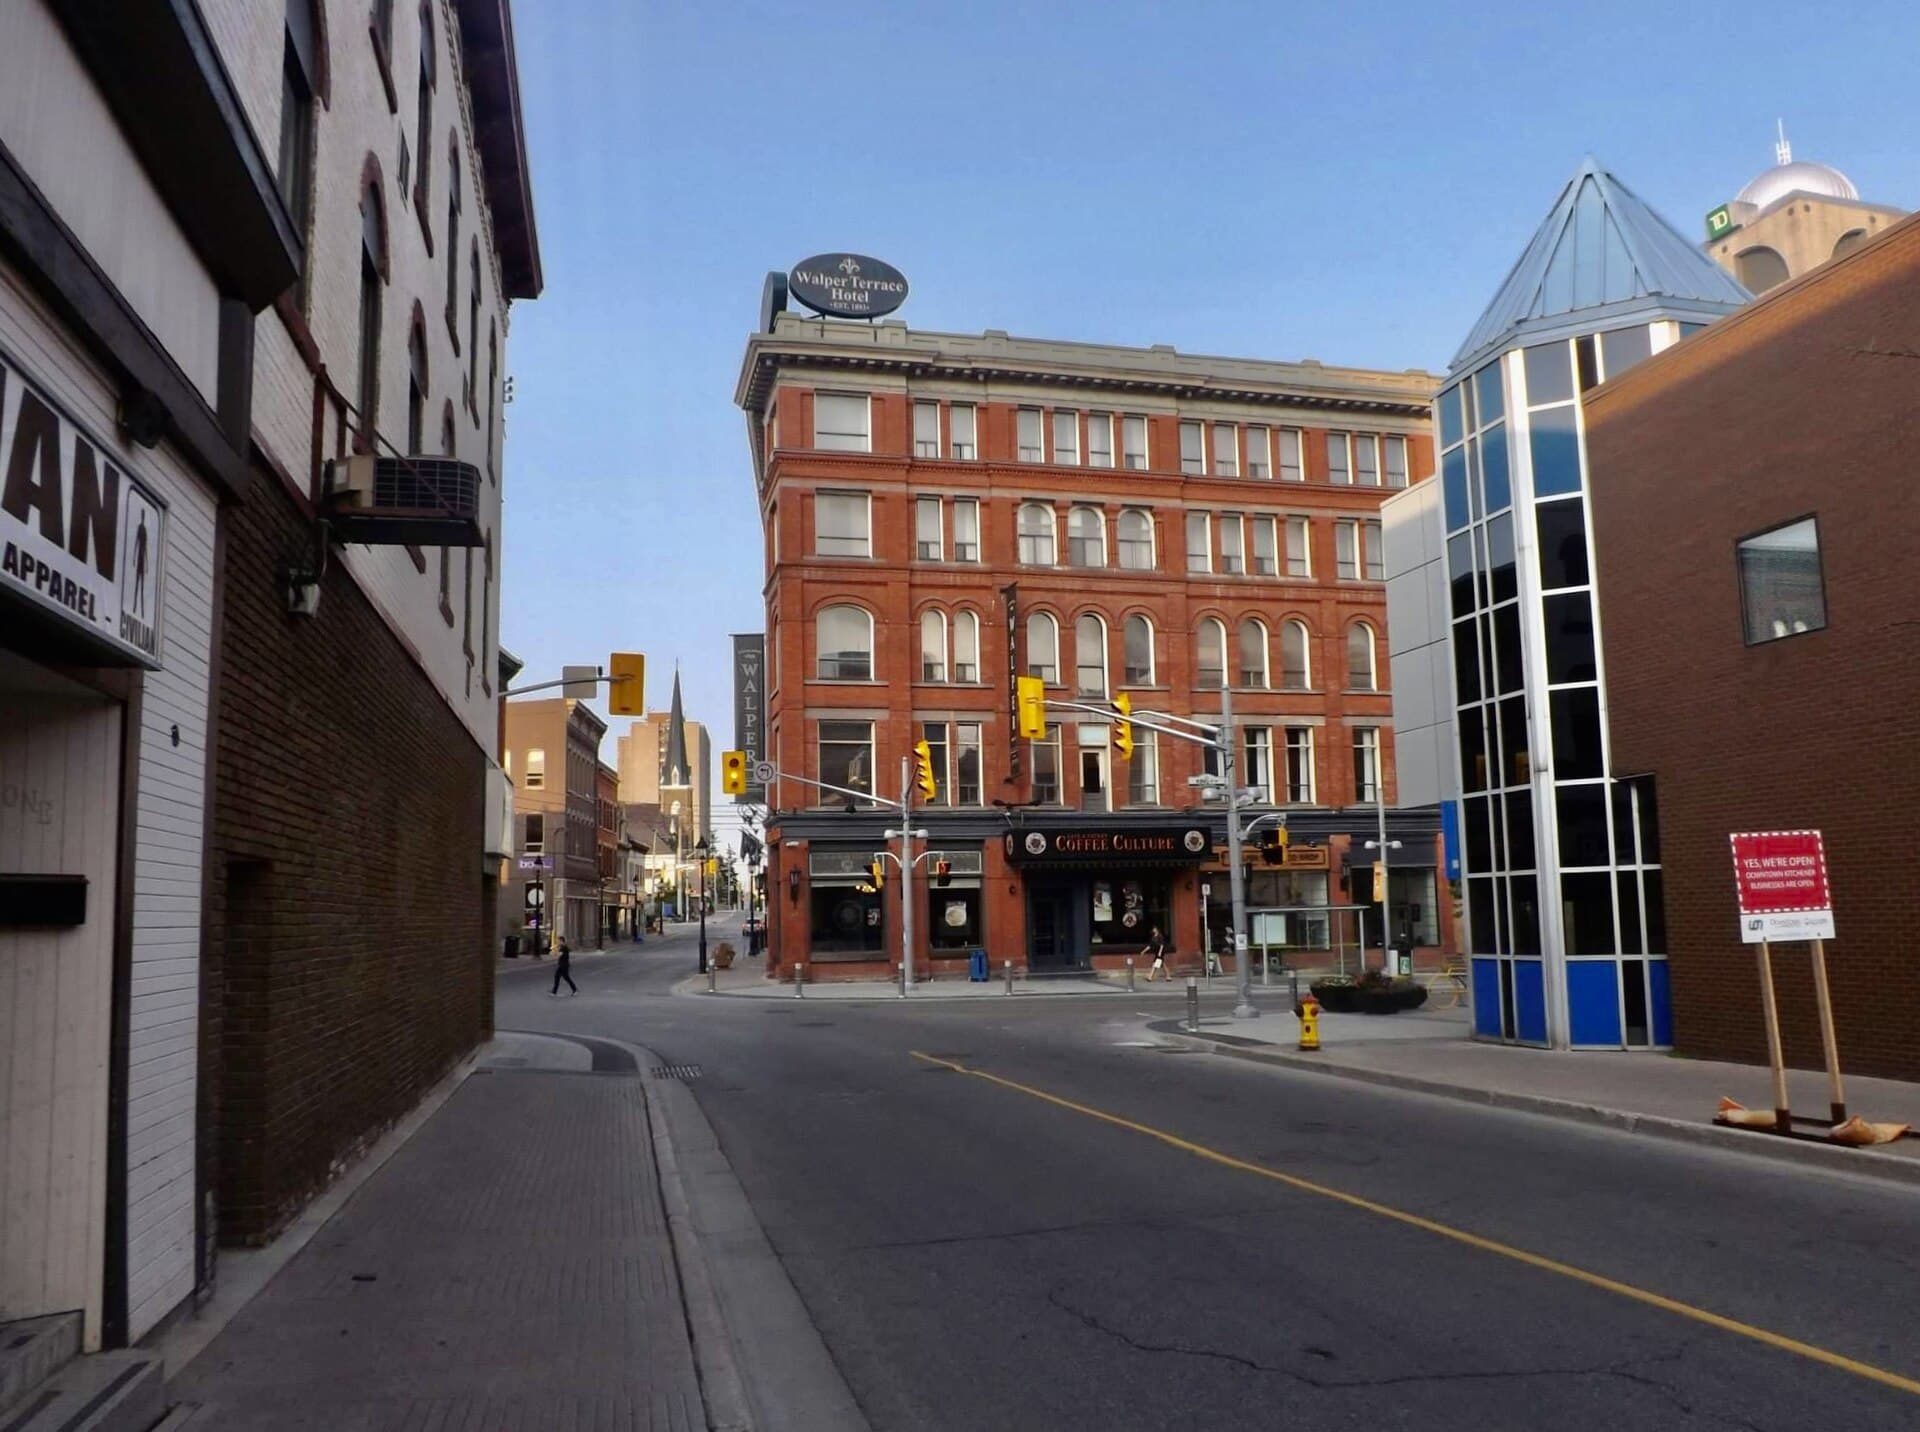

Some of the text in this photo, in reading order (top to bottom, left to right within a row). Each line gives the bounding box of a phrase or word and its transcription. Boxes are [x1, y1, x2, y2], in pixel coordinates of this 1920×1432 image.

[1709, 211, 1728, 231] TD
[797, 271, 904, 292] Walper Terrace
[832, 288, 869, 303] Hotel
[0, 362, 119, 583] AN
[2, 541, 97, 622] APPAREL
[121, 610, 155, 657] CIVILIAN
[742, 663, 759, 763] WALPER
[1744, 858, 1762, 868] YES,
[1762, 857, 1787, 867] WE'RE
[1746, 870, 1783, 879] DOWNTOWN
